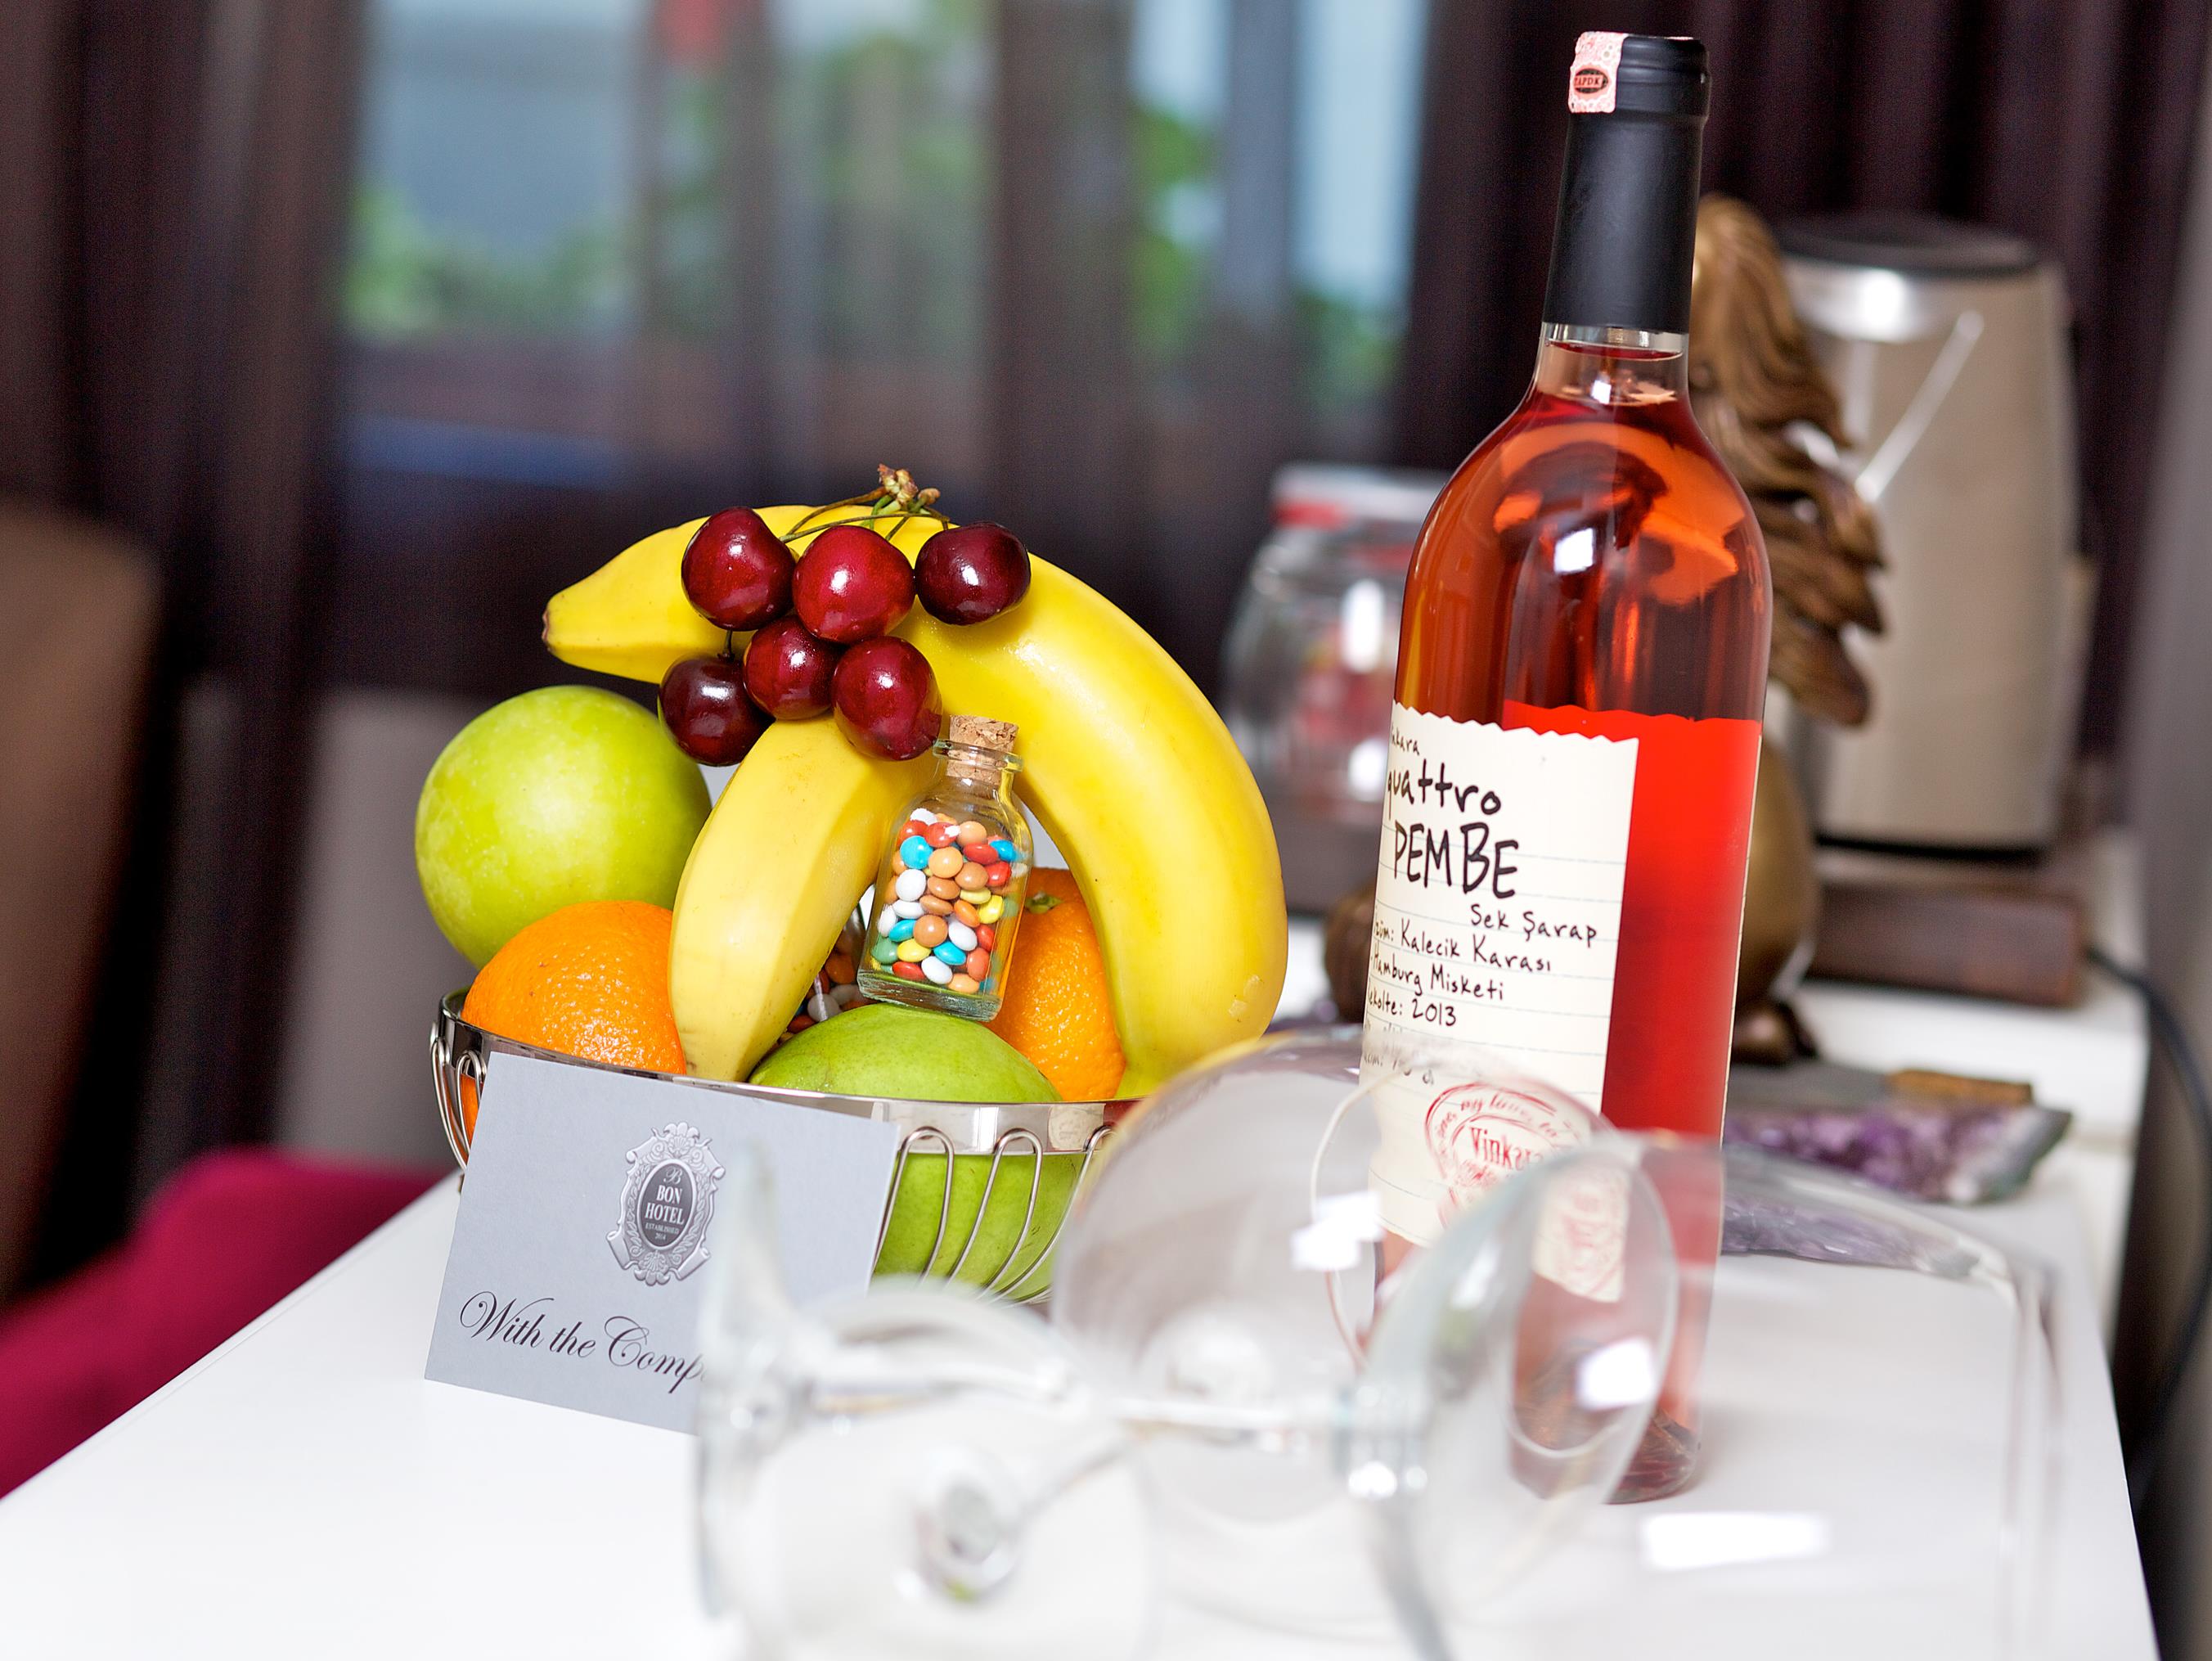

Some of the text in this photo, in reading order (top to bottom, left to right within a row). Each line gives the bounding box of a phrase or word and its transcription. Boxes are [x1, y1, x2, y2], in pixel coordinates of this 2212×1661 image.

[1388, 758, 1502, 821] quattro
[1394, 820, 1519, 898] PEMBE
[1374, 917, 1551, 972] züm: Kalecik Karası
[1470, 903, 1598, 948] Sek Şarap
[1373, 939, 1504, 1000] Hamburg Misketi
[1368, 982, 1457, 1027] ekolte: 2013
[645, 1202, 685, 1225] HOTEL
[656, 1184, 683, 1205] BON
[460, 1290, 555, 1349] With
[549, 1321, 596, 1358] the
